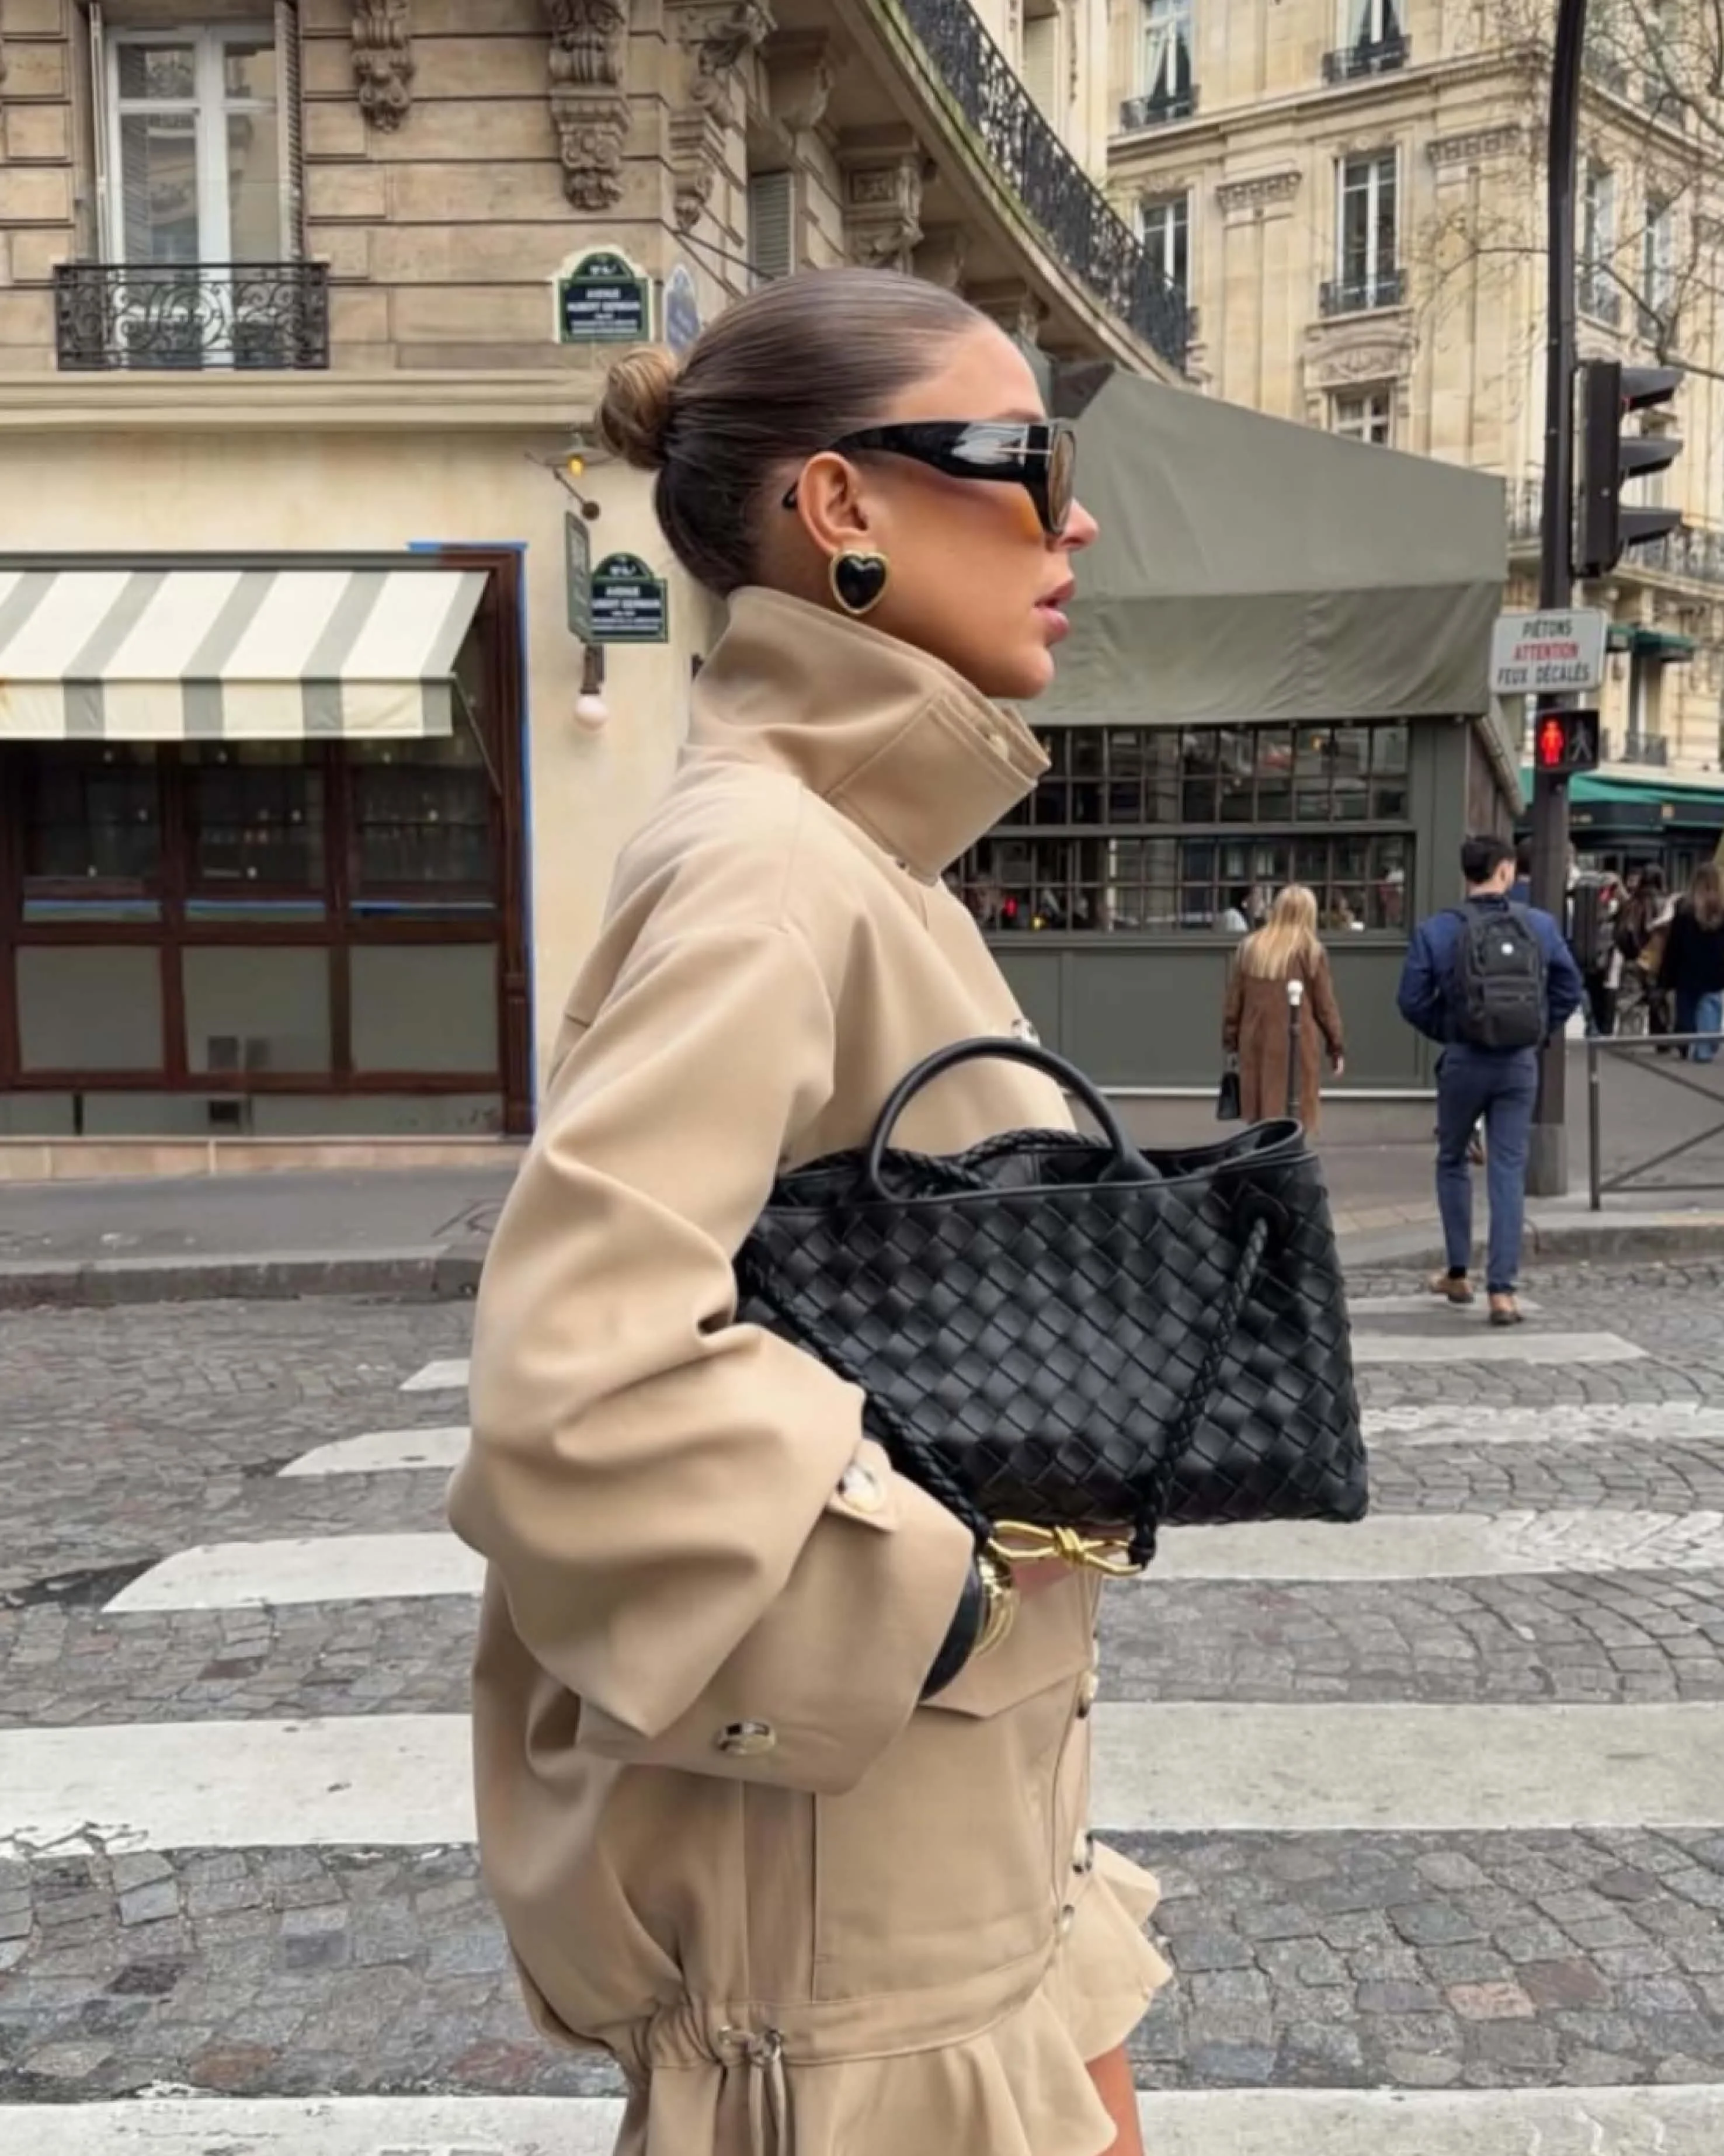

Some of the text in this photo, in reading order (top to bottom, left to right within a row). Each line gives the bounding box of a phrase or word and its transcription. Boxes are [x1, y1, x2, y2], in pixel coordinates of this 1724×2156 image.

[1512, 642, 1579, 661] ATTENTION
[1497, 662, 1590, 685] FEUX DÉCALÉS
